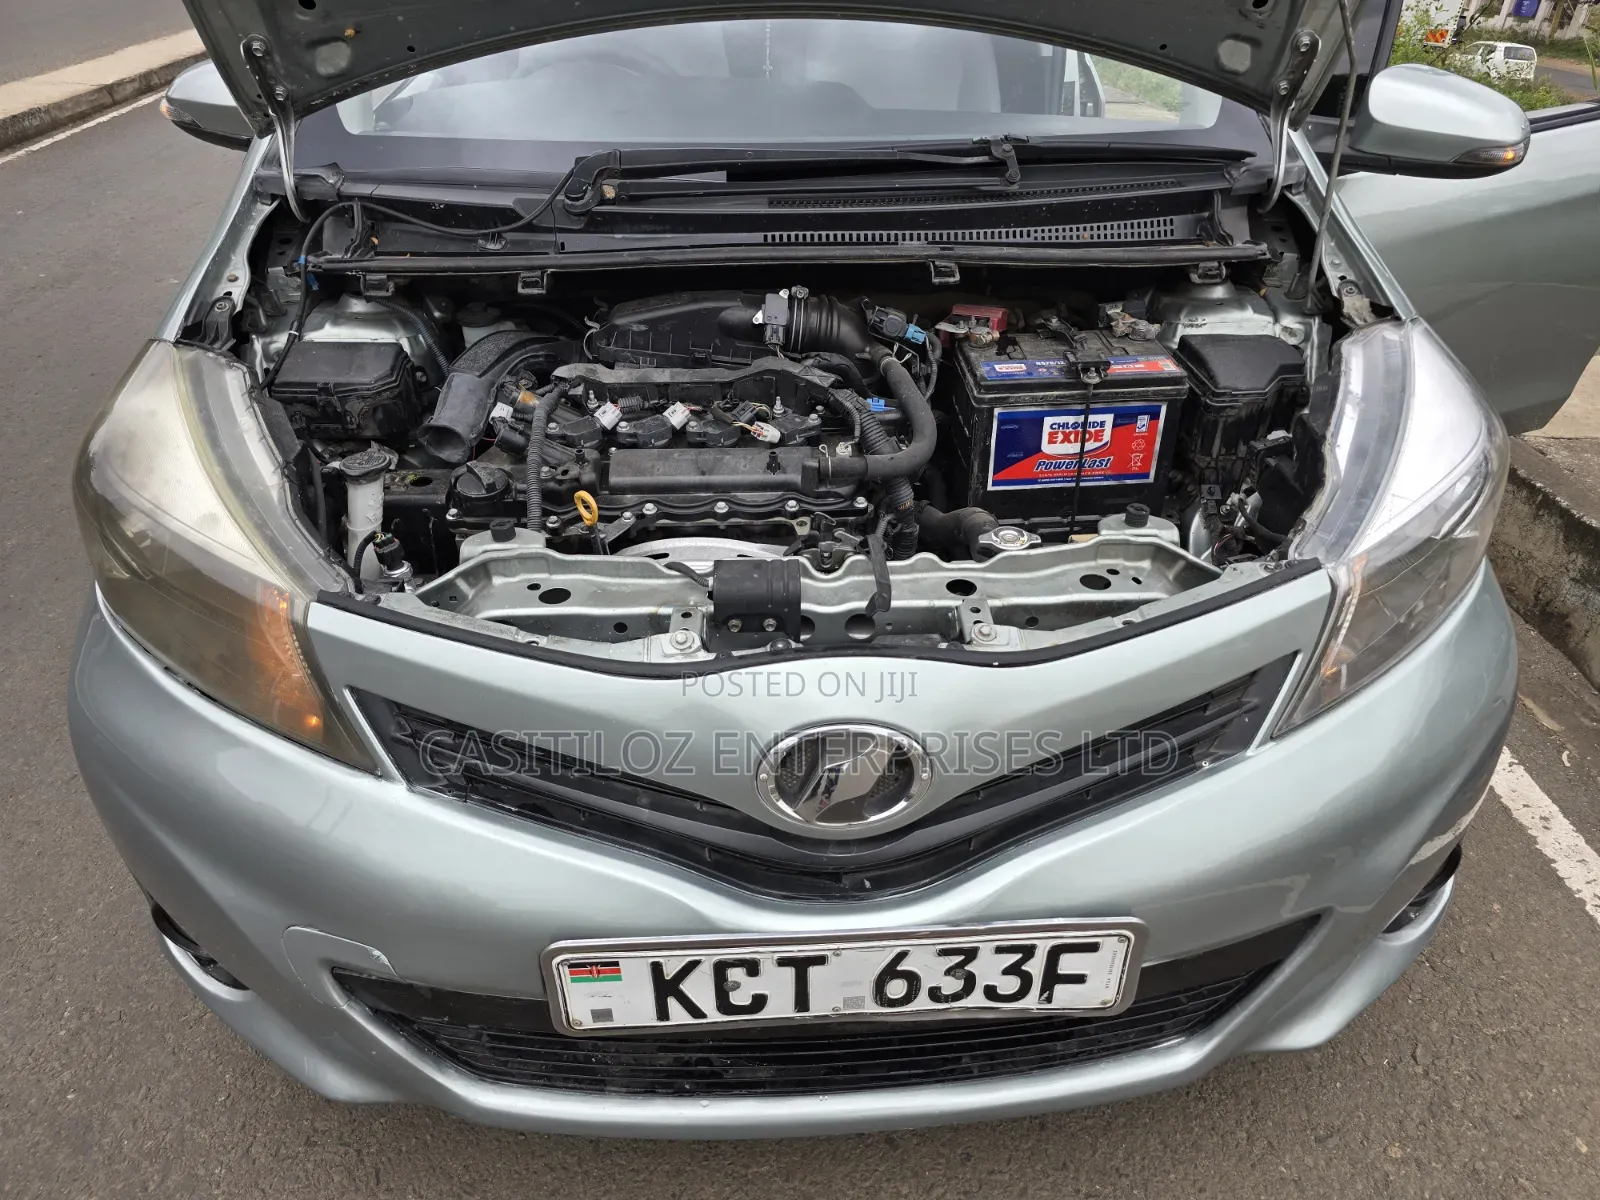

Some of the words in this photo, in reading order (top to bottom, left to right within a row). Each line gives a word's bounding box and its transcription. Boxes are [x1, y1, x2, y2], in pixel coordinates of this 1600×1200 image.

[1047, 429, 1105, 444] EXIDE
[649, 953, 829, 1022] KCT
[874, 941, 1102, 1008] 633F
